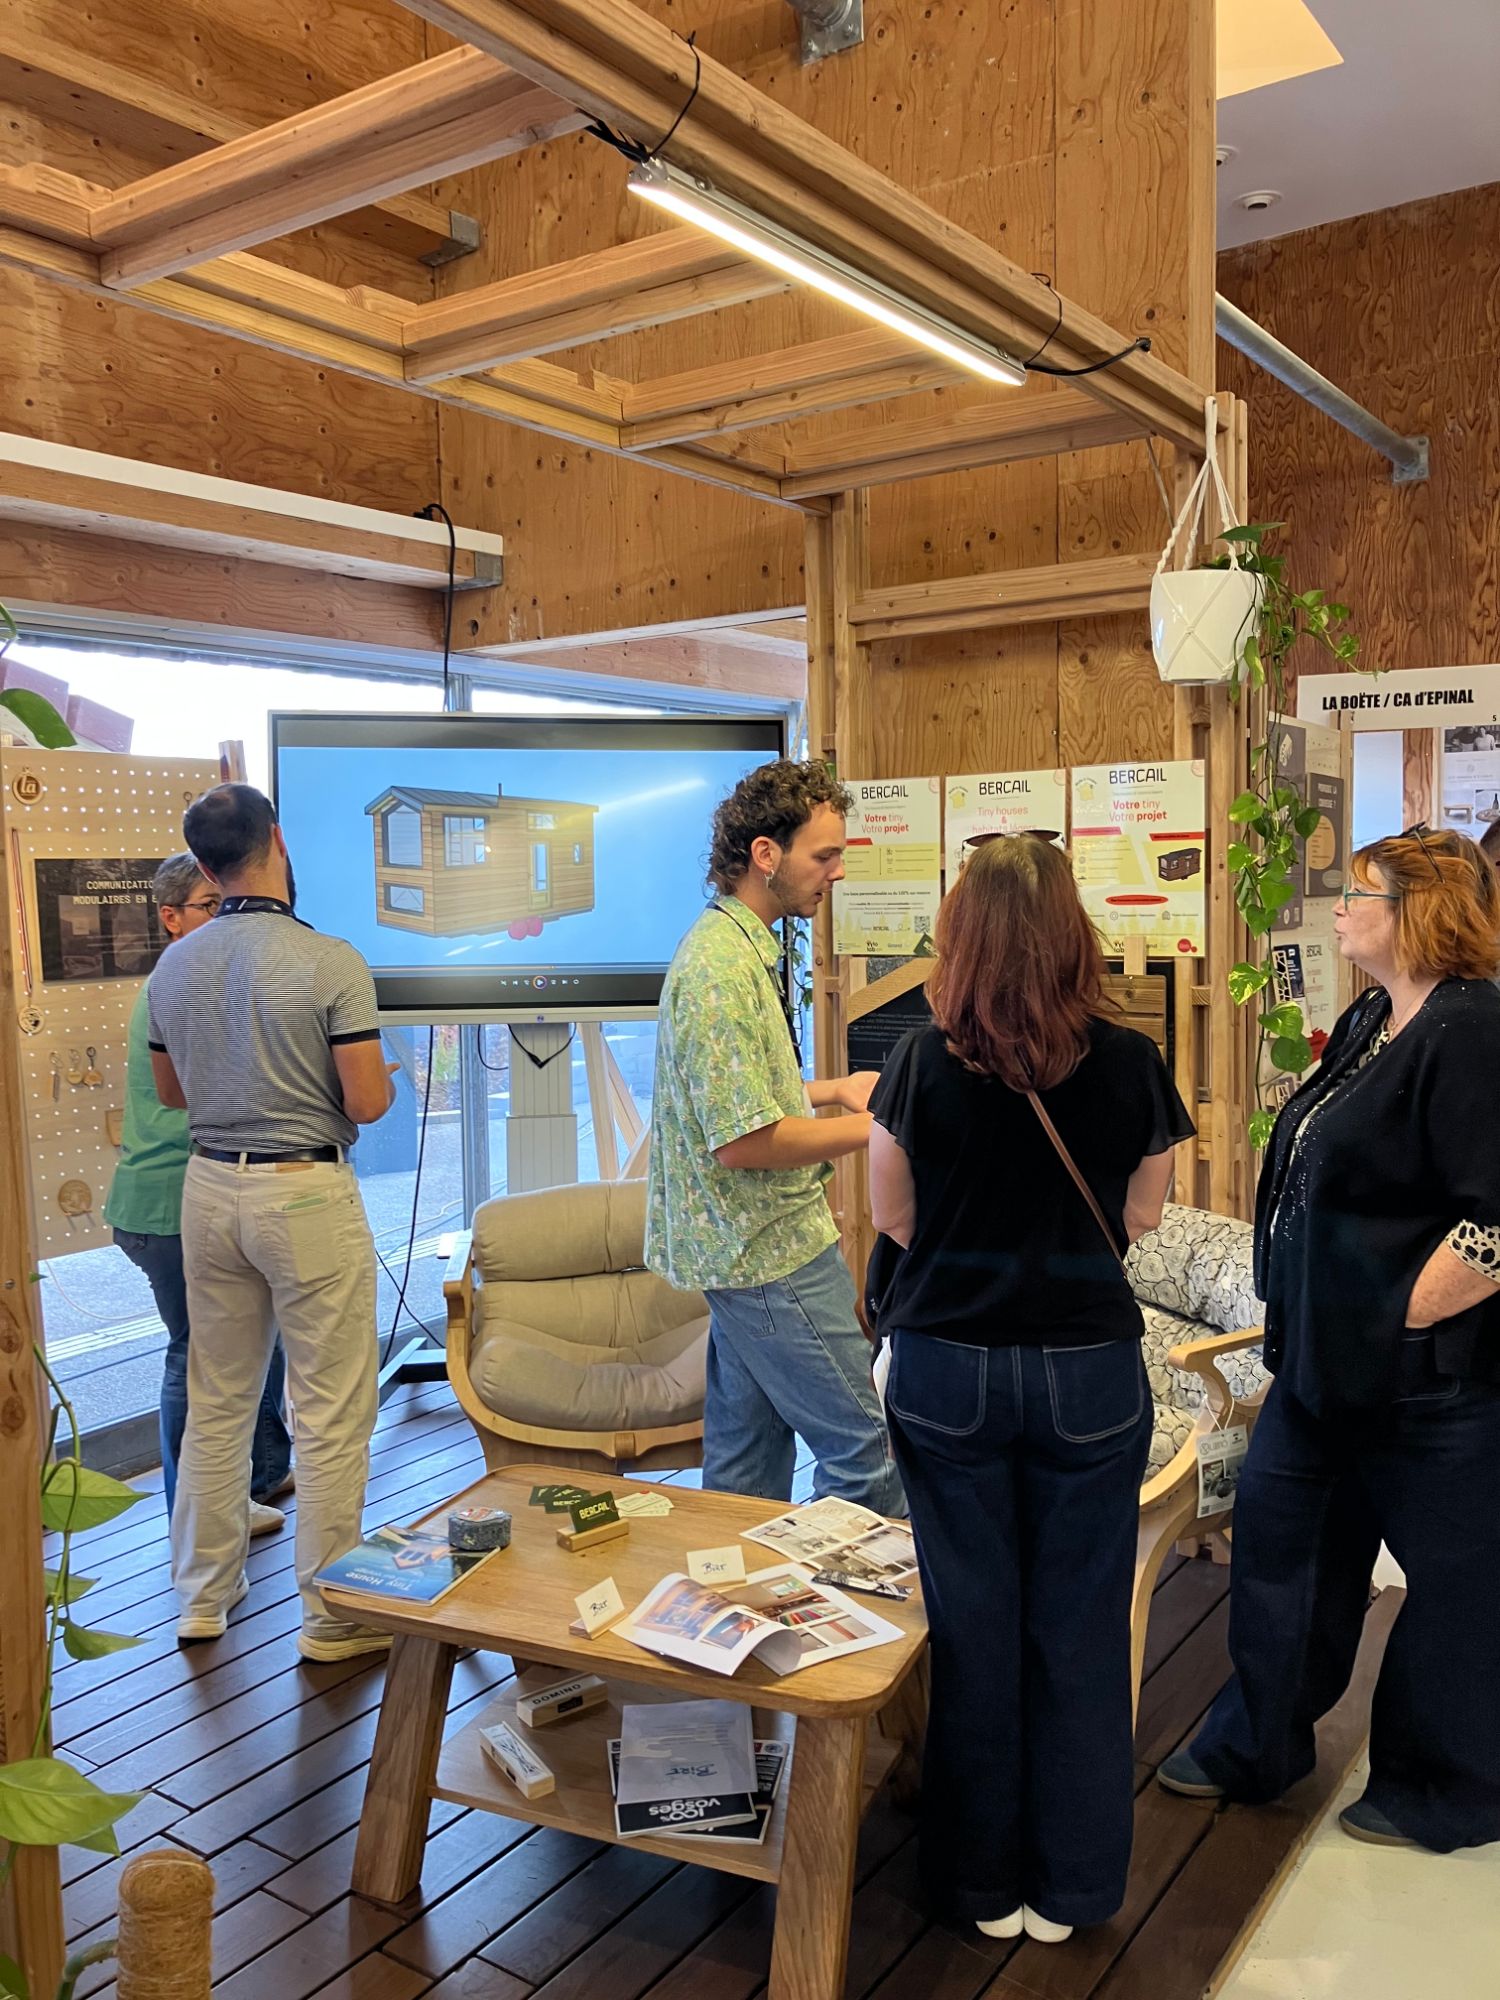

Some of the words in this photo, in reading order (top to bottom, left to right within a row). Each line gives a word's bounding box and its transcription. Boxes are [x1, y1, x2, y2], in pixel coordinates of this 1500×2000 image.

[1322, 696, 1338, 710] LA
[1340, 692, 1381, 709] BOËTE
[1383, 693, 1390, 708] /
[1393, 692, 1412, 707] CA
[1414, 689, 1474, 706] d'EPINAL
[1109, 768, 1167, 784] BERCAIL
[861, 785, 909, 799] BERCAIL
[979, 780, 1031, 796] BERCAIL
[977, 807, 994, 817] Tiny
[995, 805, 1028, 815] houses
[1113, 800, 1140, 810] Votre
[1142, 800, 1160, 810] tiny
[864, 814, 887, 823] Votre
[888, 813, 904, 823] tiny
[1109, 812, 1134, 822] Votre
[1137, 811, 1167, 822] projet
[861, 825, 882, 833] Votre
[884, 824, 909, 834] projet
[72, 895, 131, 904] MODULAIRES
[135, 895, 147, 904] EN
[579, 1501, 610, 1519] BERCAIL
[345, 1571, 384, 1585] House
[532, 1683, 581, 1705] DOMINO
[649, 1798, 720, 1815] vosges
